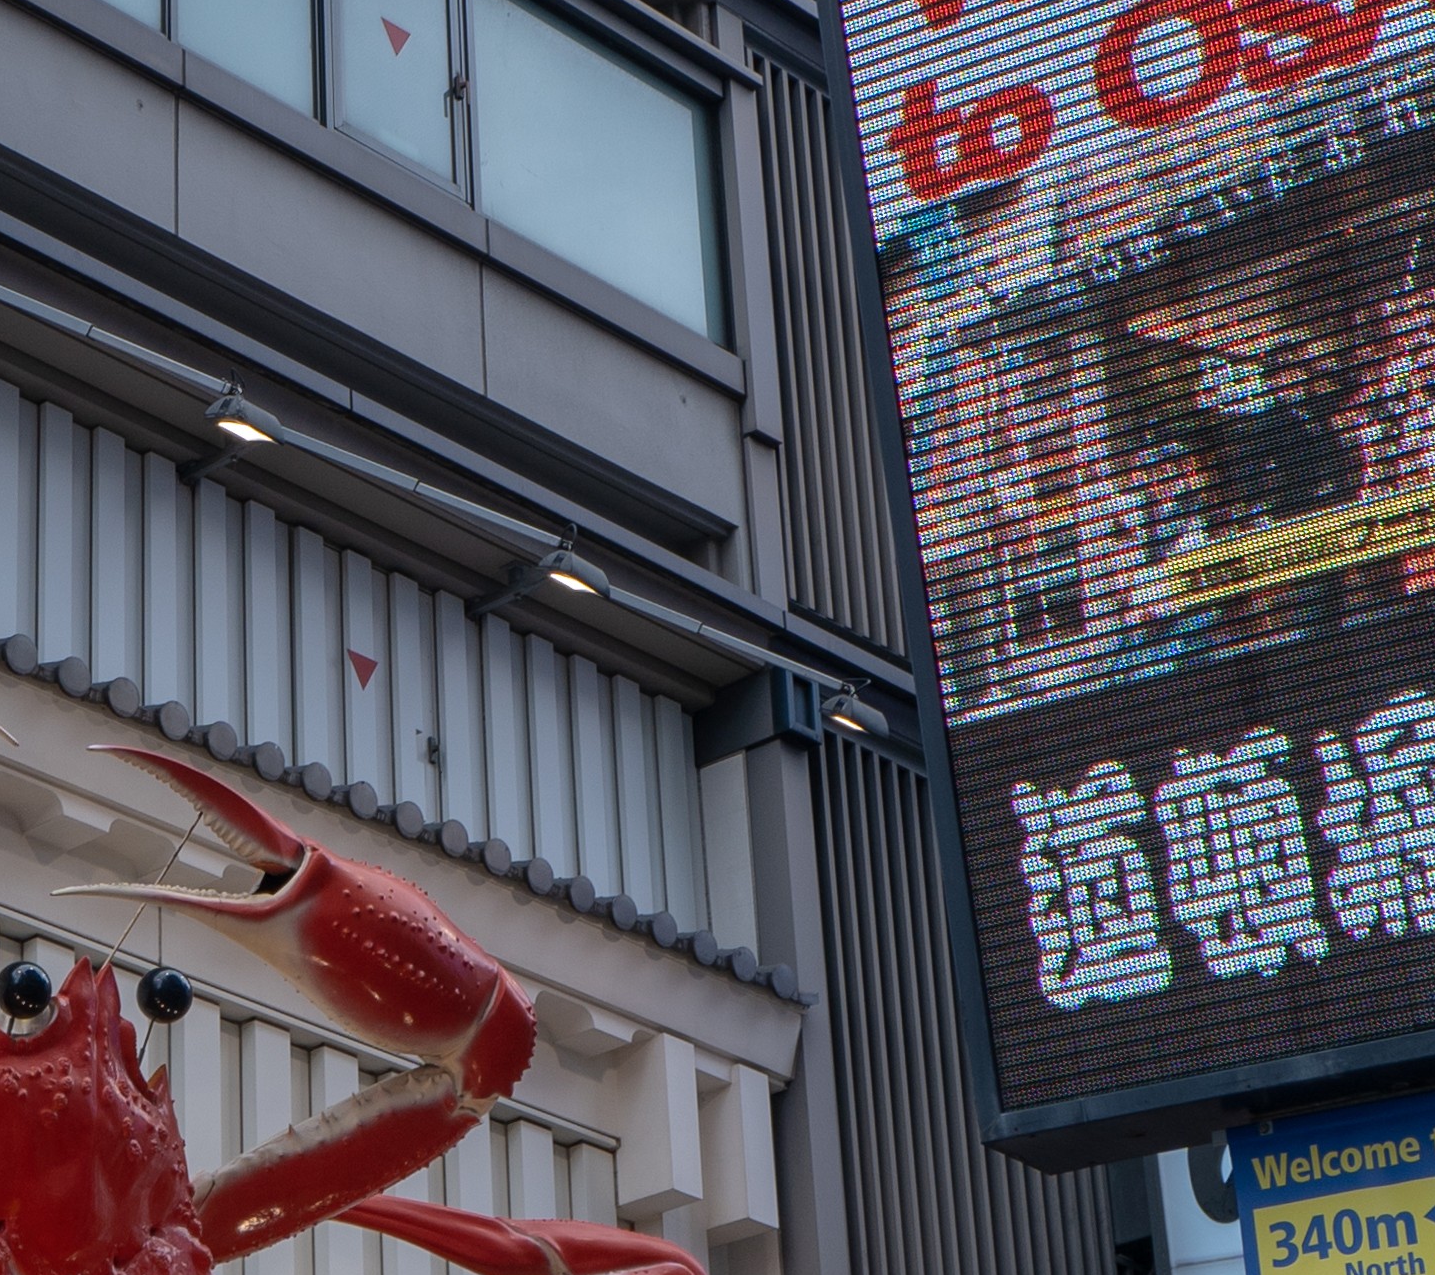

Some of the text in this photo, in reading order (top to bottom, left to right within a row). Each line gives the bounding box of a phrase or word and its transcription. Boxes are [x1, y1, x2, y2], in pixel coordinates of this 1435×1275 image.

[884, 71, 1058, 203] to
[1252, 1134, 1421, 1191] Welcome
[1269, 1205, 1419, 1270] 340m
